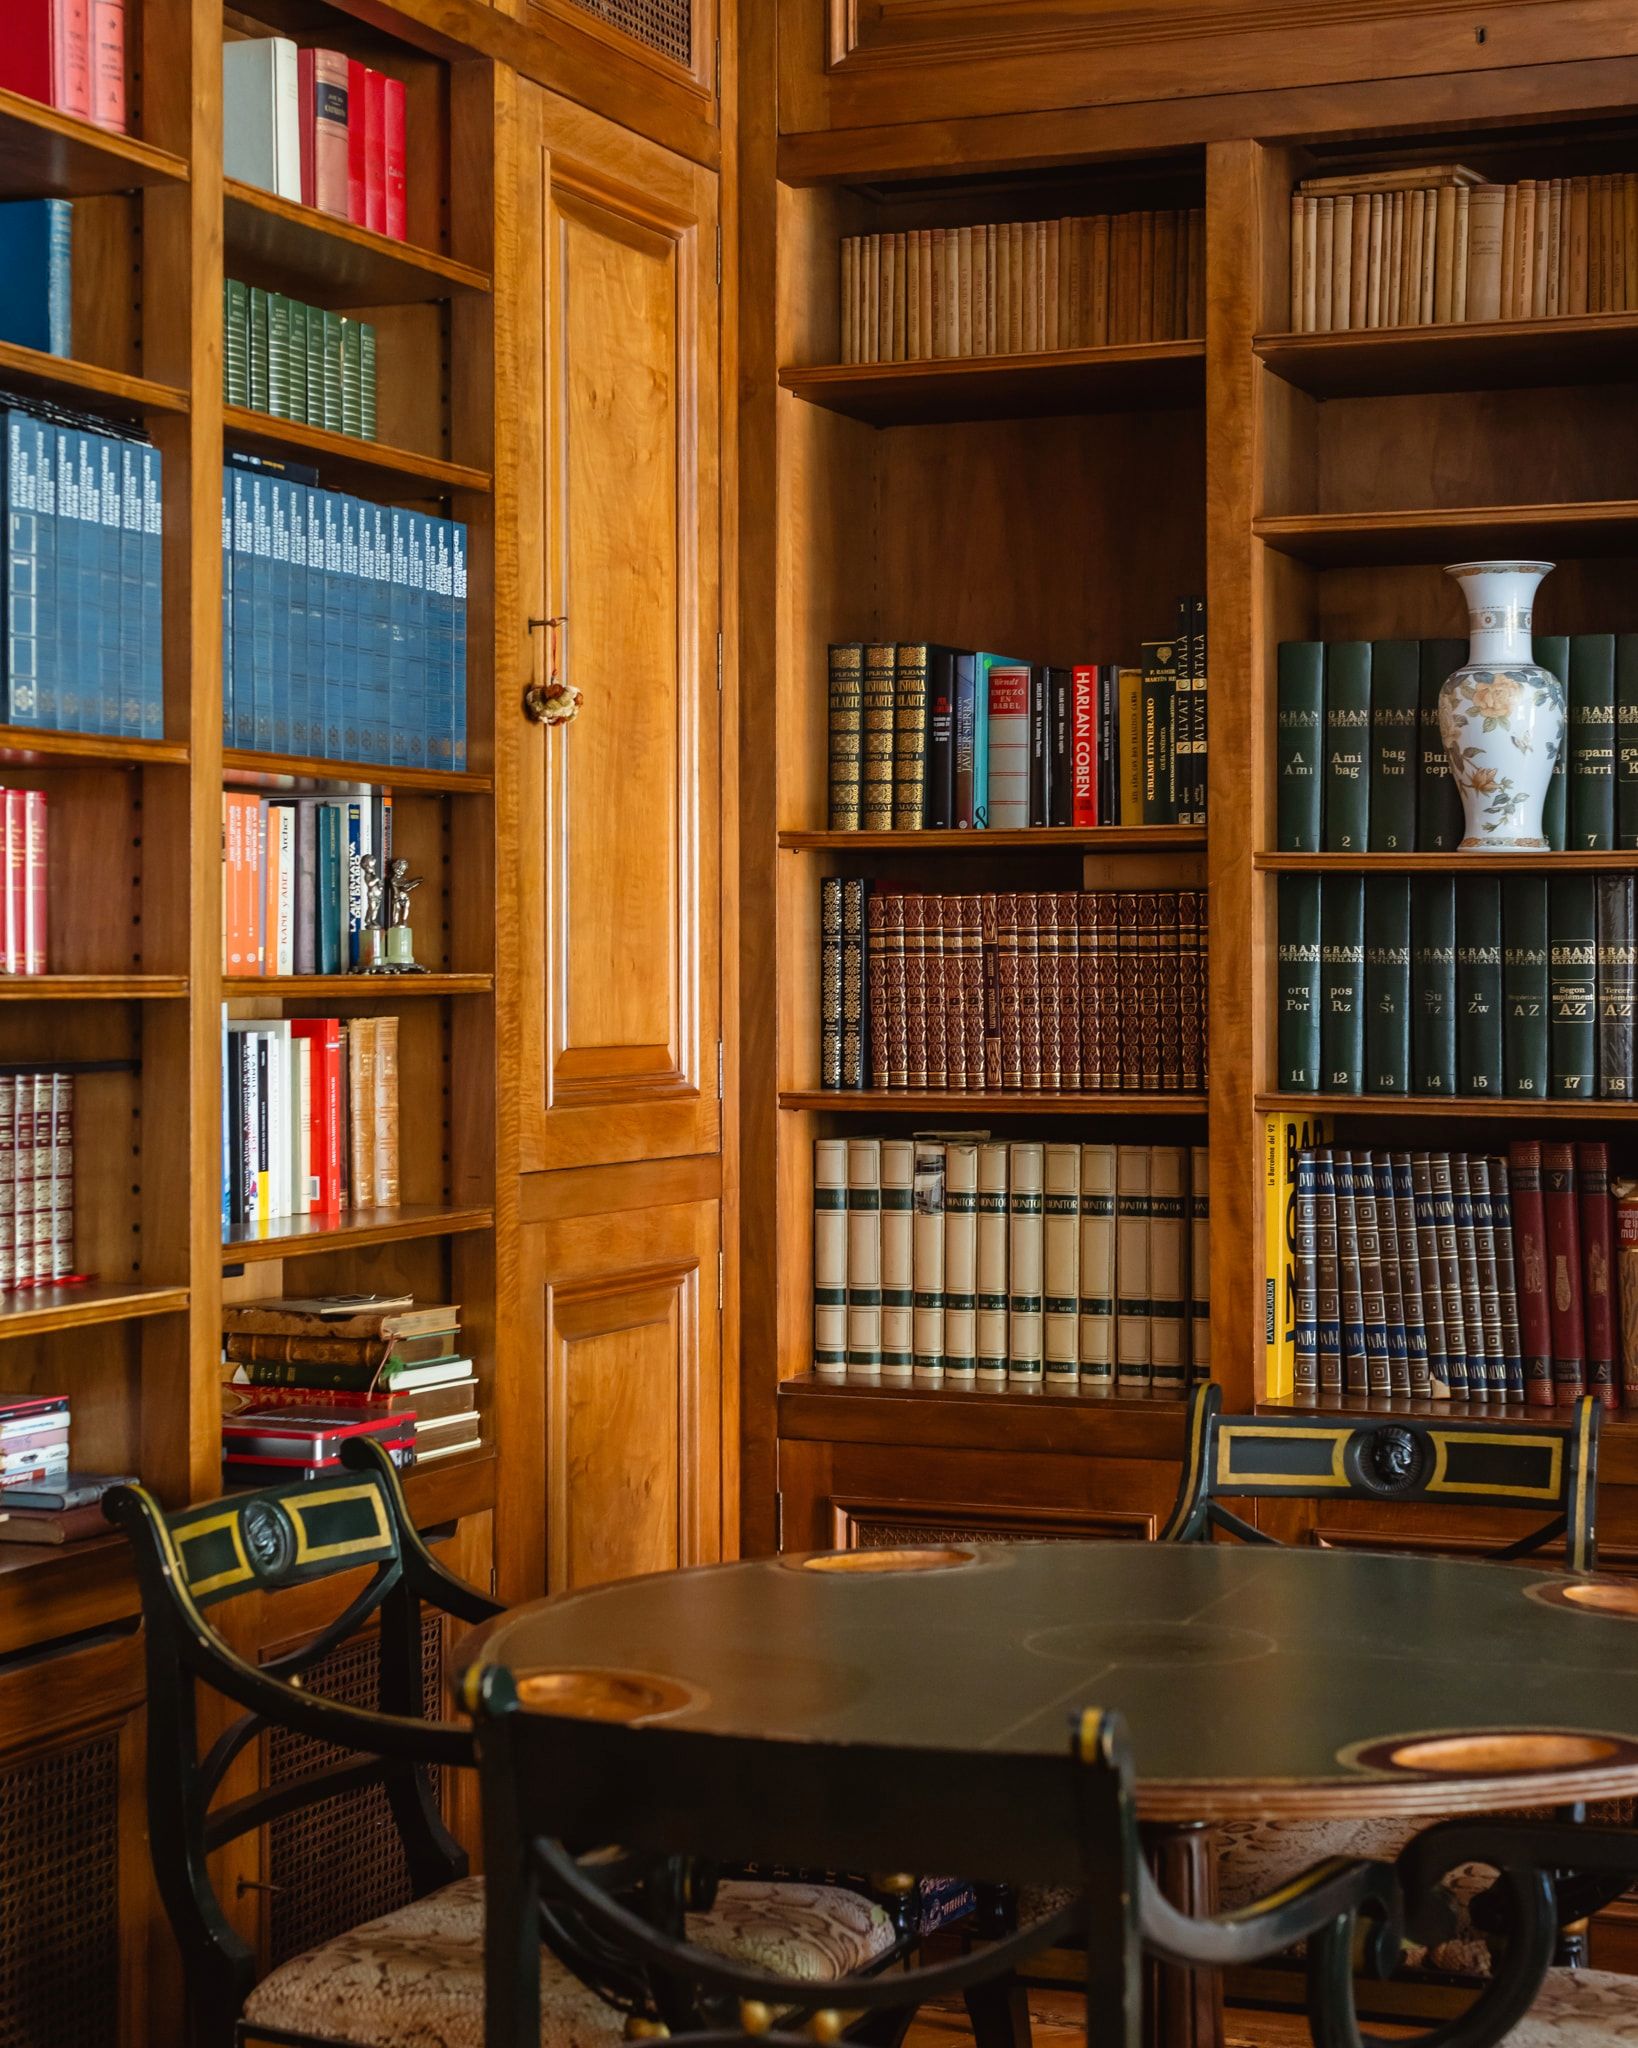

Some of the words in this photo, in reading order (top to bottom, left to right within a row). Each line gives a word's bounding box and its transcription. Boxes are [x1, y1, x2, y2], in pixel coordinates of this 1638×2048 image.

[11, 425, 20, 506] enciclopedia
[36, 431, 44, 512] enciclopedia
[58, 436, 66, 516] enciclopedia
[80, 440, 88, 520] enciclopedia
[1197, 603, 1203, 611] 2
[1076, 672, 1090, 737] HARLAN
[963, 698, 972, 735] SIERRA
[1279, 711, 1319, 719] GRAN
[1328, 710, 1368, 718] GRAN
[1375, 709, 1415, 718] GRAN
[1176, 697, 1191, 754] SALVAT
[1192, 696, 1207, 754] SALVAT
[962, 736, 972, 773] JAVIER
[1293, 752, 1304, 763] A
[1331, 752, 1362, 763] Ami
[1382, 748, 1406, 762] bag
[1076, 743, 1090, 797] COBEN
[1284, 765, 1313, 775] Ami
[1335, 764, 1360, 779] bag
[1383, 764, 1405, 775] bui
[1426, 766, 1450, 777] cep
[1294, 836, 1301, 847] 1
[1342, 836, 1350, 847] 2
[1387, 836, 1396, 847] 3
[1433, 836, 1442, 846] 4
[1588, 835, 1597, 847] 7
[350, 918, 356, 932] LA
[1279, 945, 1320, 953] GRAN
[1323, 946, 1364, 954] GRAN
[1369, 948, 1409, 956] GRAN
[1458, 947, 1499, 956] GRAN
[1552, 947, 1594, 956] GRAN
[1288, 987, 1309, 998] orq
[1330, 987, 1352, 998] pos
[1424, 990, 1442, 1001] Su
[1559, 987, 1585, 995] Segon
[1474, 993, 1482, 1001] u
[1287, 1000, 1309, 1011] Por
[1333, 1001, 1351, 1012] Rz
[1379, 1003, 1395, 1013] St
[1427, 1003, 1441, 1014] Tz
[1468, 1002, 1489, 1013] Zw
[1559, 1003, 1587, 1016] A-Z
[1604, 1004, 1632, 1016] A-Z
[1291, 1070, 1305, 1082] 11
[1332, 1072, 1348, 1084] 12
[1379, 1075, 1394, 1086] 13
[1427, 1076, 1441, 1087] 14
[1473, 1076, 1488, 1087] 15
[1519, 1079, 1533, 1089] 16
[1564, 1077, 1580, 1088] 17
[1609, 1079, 1625, 1090] 18
[1268, 1124, 1275, 1133] 92
[1267, 1333, 1273, 1342] LA
